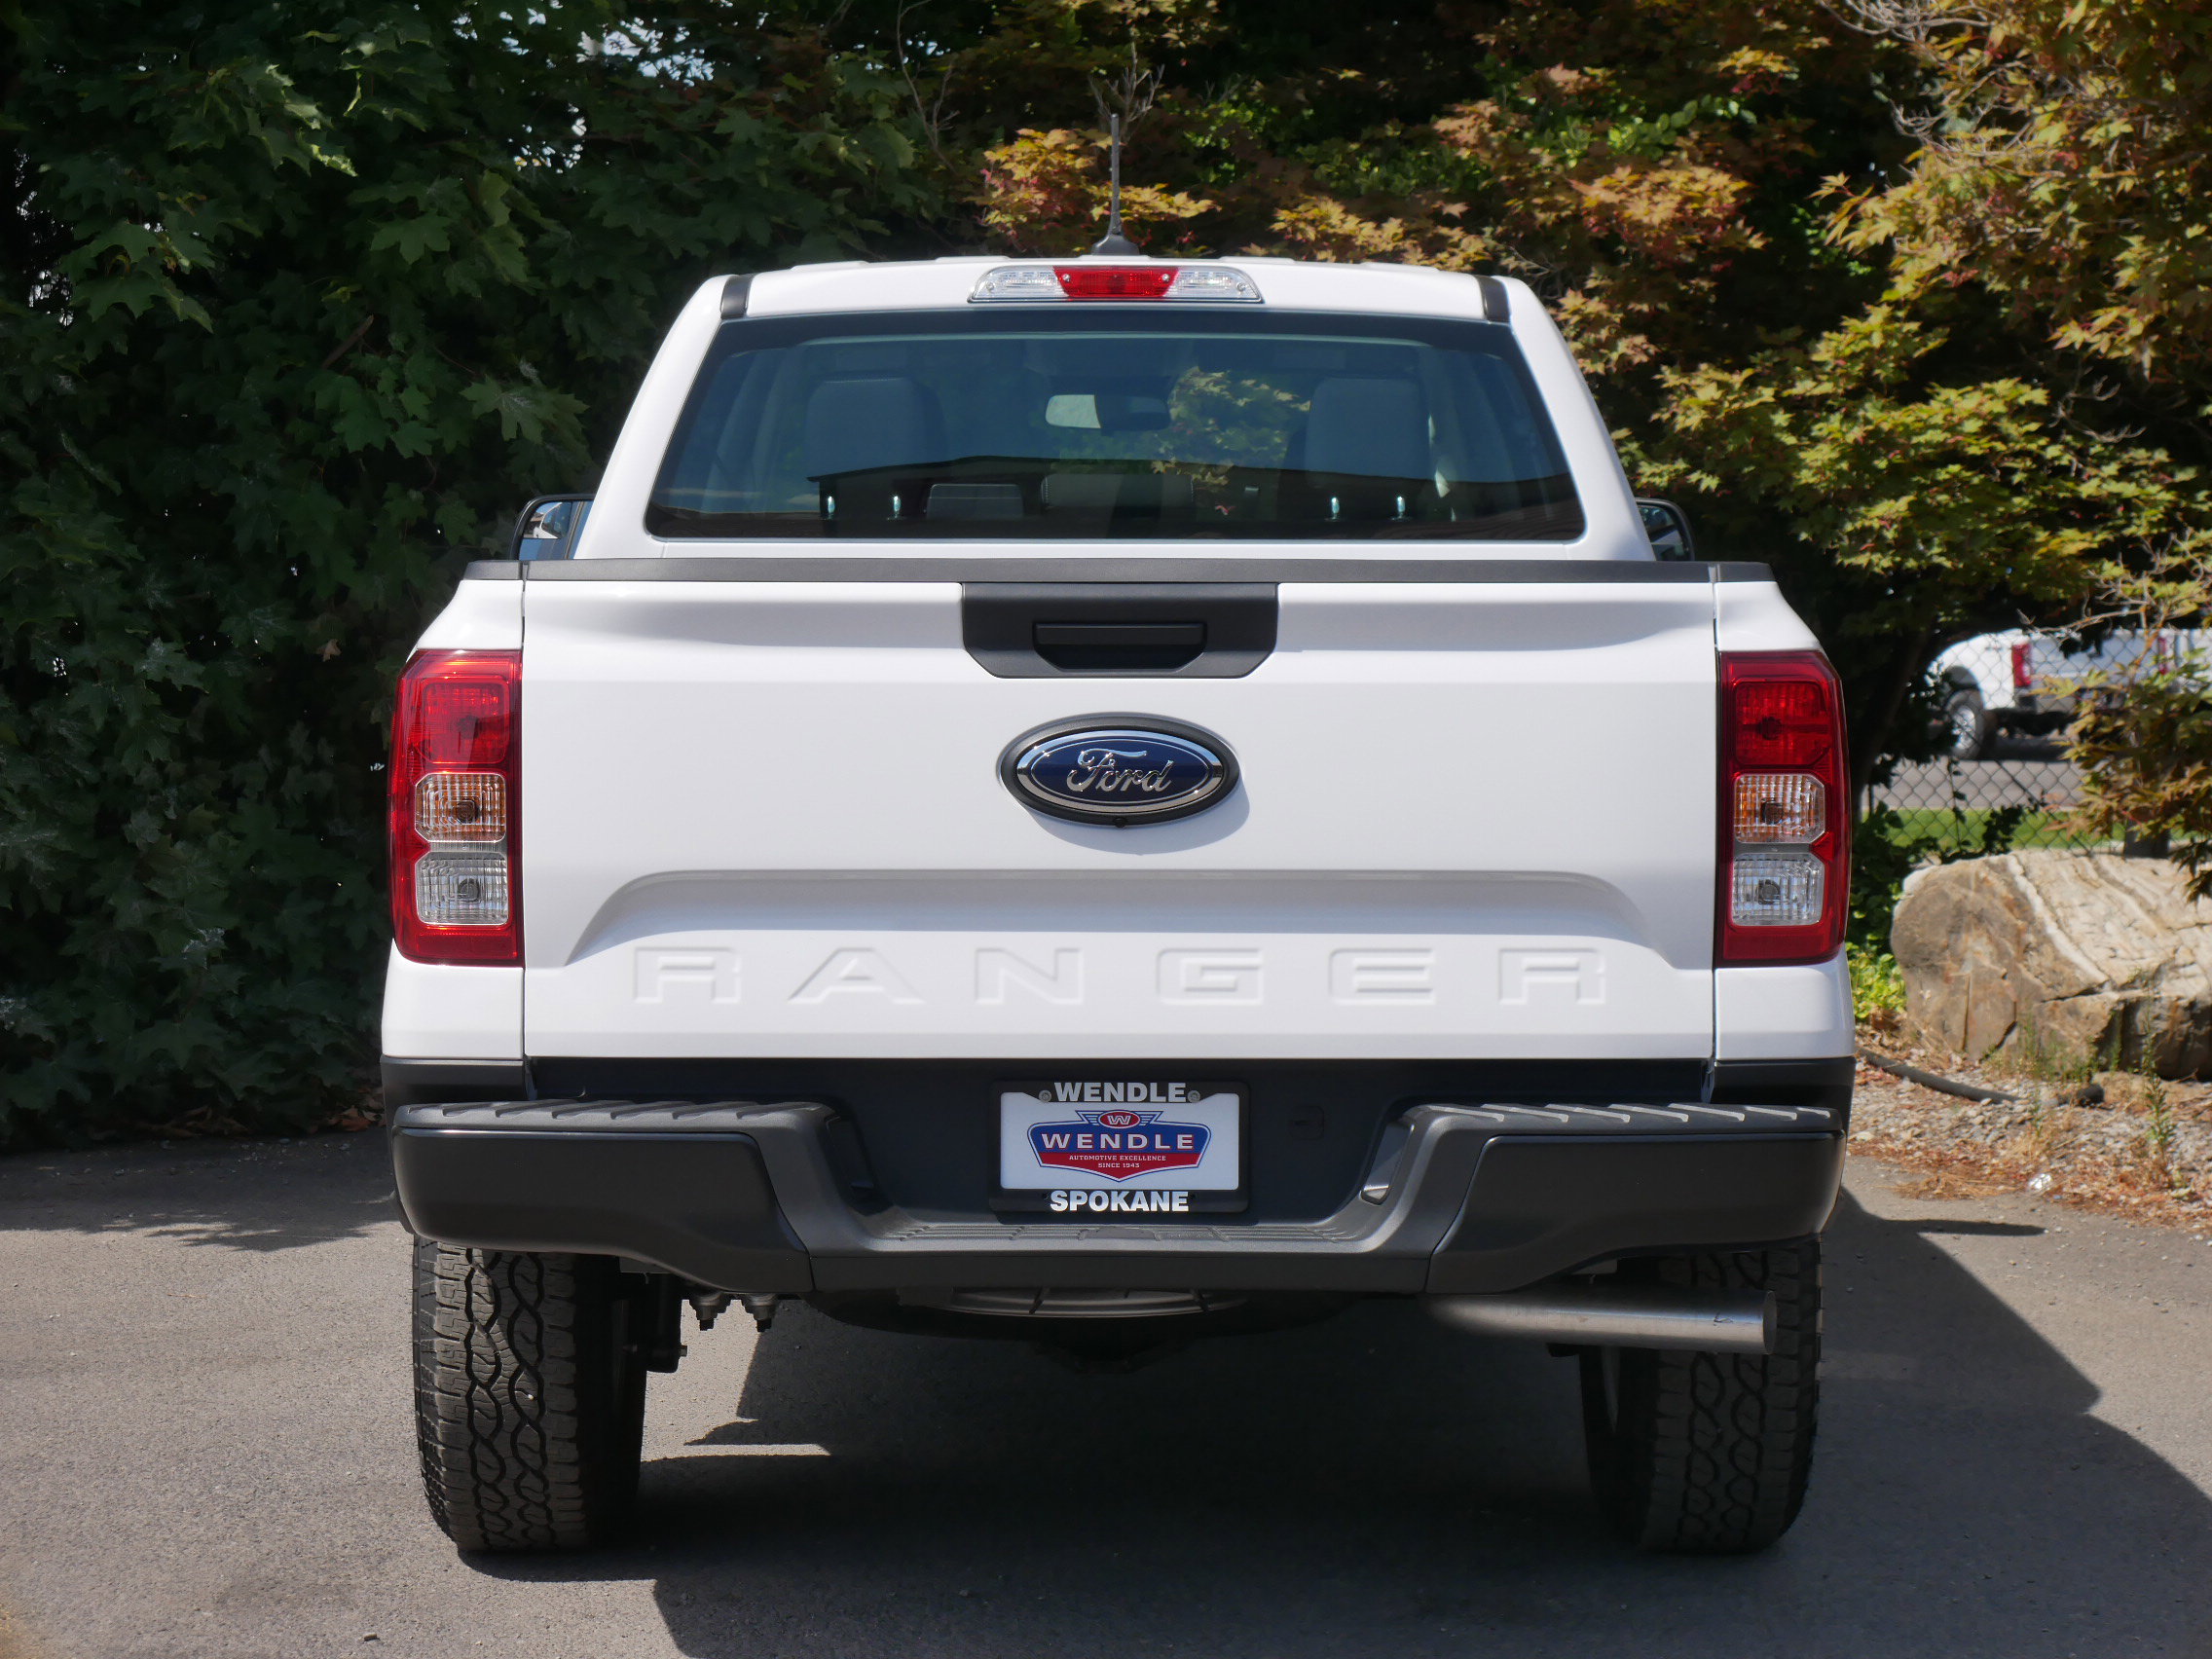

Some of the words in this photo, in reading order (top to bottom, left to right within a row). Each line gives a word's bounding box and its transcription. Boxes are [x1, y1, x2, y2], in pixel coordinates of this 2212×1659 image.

[1067, 748, 1174, 793] Ford
[633, 946, 1607, 1006] RANGER
[1054, 1082, 1187, 1103] WENDLE
[1042, 1133, 1194, 1149] WENDLE
[1050, 1190, 1189, 1212] SPOKANE
